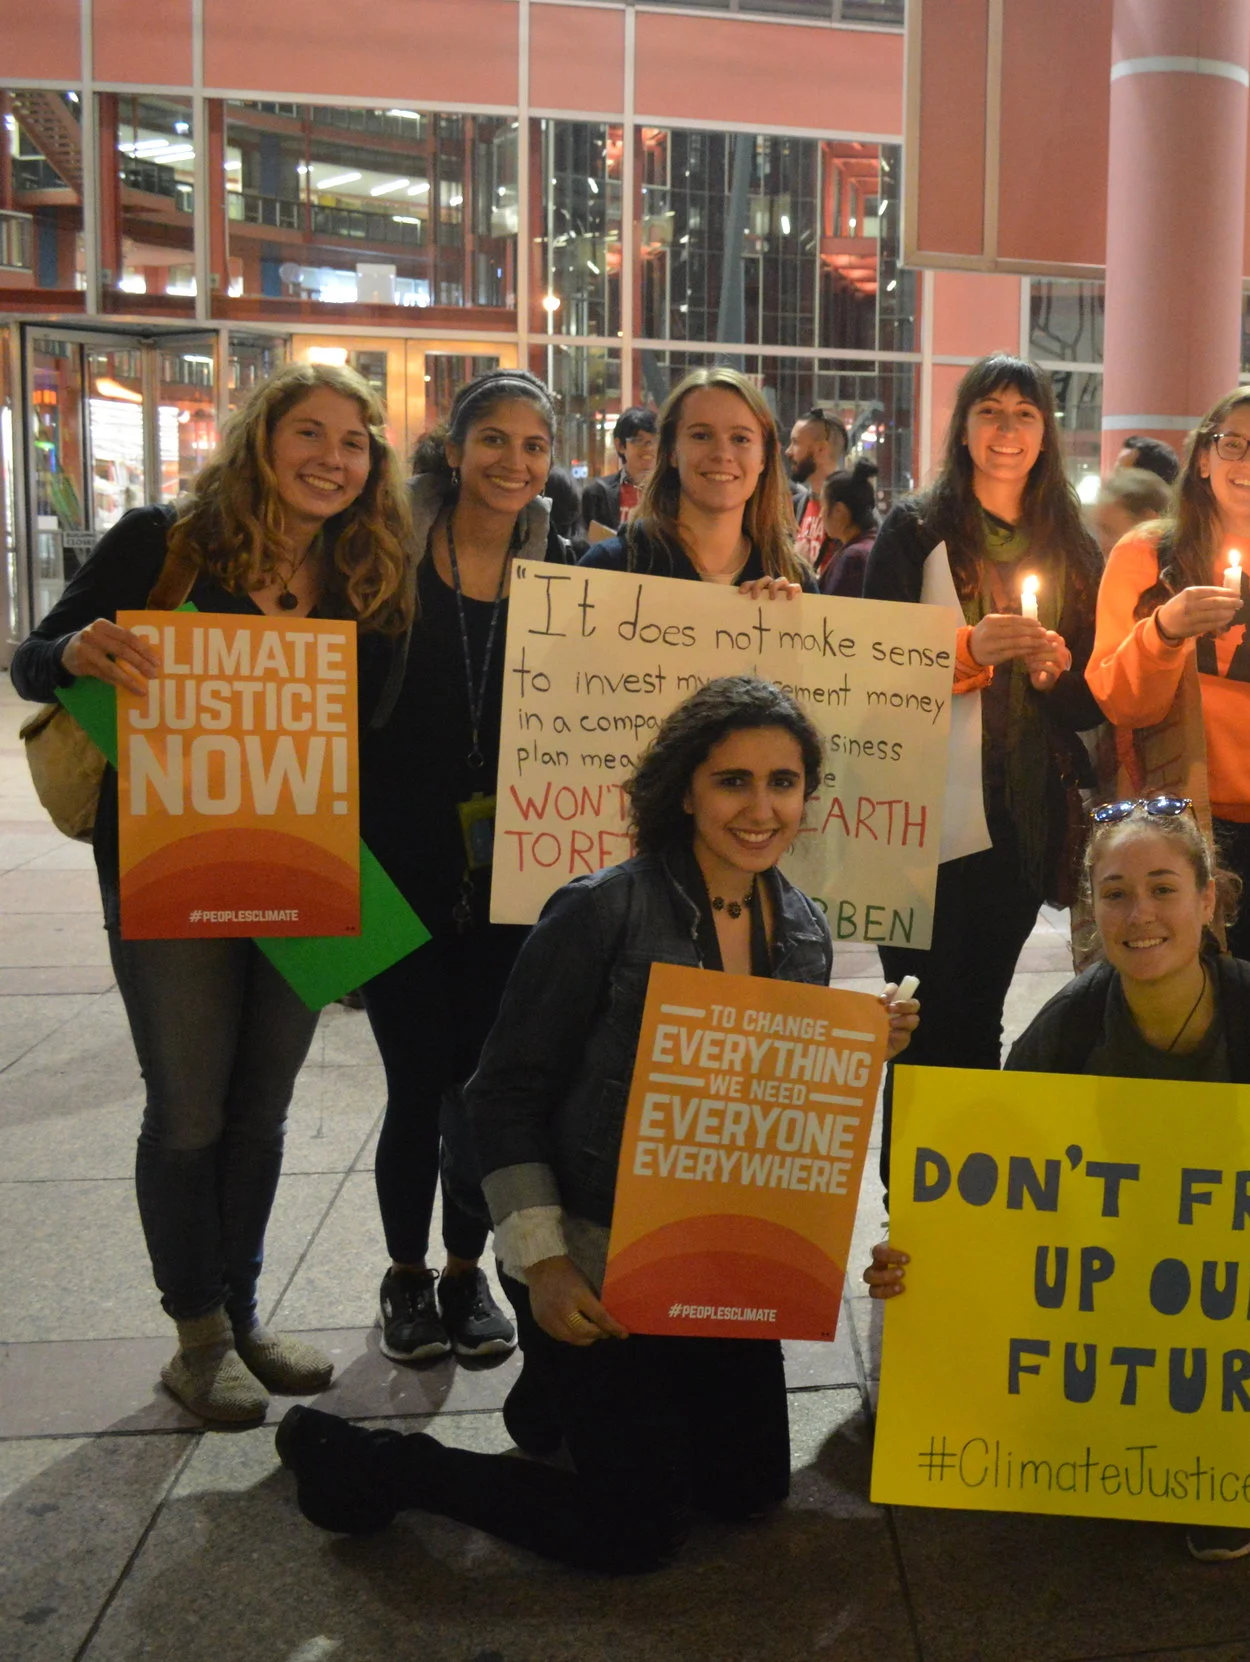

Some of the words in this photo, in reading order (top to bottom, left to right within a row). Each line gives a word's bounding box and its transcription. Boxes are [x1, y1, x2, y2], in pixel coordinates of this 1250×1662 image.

[617, 583, 697, 648] does
[715, 606, 772, 655] not
[778, 616, 856, 657] make
[871, 641, 950, 669] sense
[129, 678, 347, 732] JUSTICE
[512, 646, 551, 698] to
[575, 664, 667, 696] invest
[866, 689, 945, 725] money
[518, 708, 543, 732] in
[552, 715, 572, 734] a
[129, 734, 349, 816] NOW!
[516, 738, 569, 777] plan
[509, 781, 627, 822] WON'T
[188, 909, 299, 923] #PEOPLESCLIMATE
[710, 1004, 737, 1029] TO
[742, 1008, 830, 1042] CHANGE
[651, 1024, 872, 1088] EVERYTHING
[709, 1073, 745, 1099] WE
[749, 1081, 808, 1106] NEED
[638, 1092, 861, 1159] EVERYONE
[633, 1140, 852, 1195] EVERYWHERE
[912, 1143, 1142, 1219] DON'T
[1033, 1244, 1116, 1313] UP
[668, 1303, 778, 1323] #PEOPLESCLIMATE
